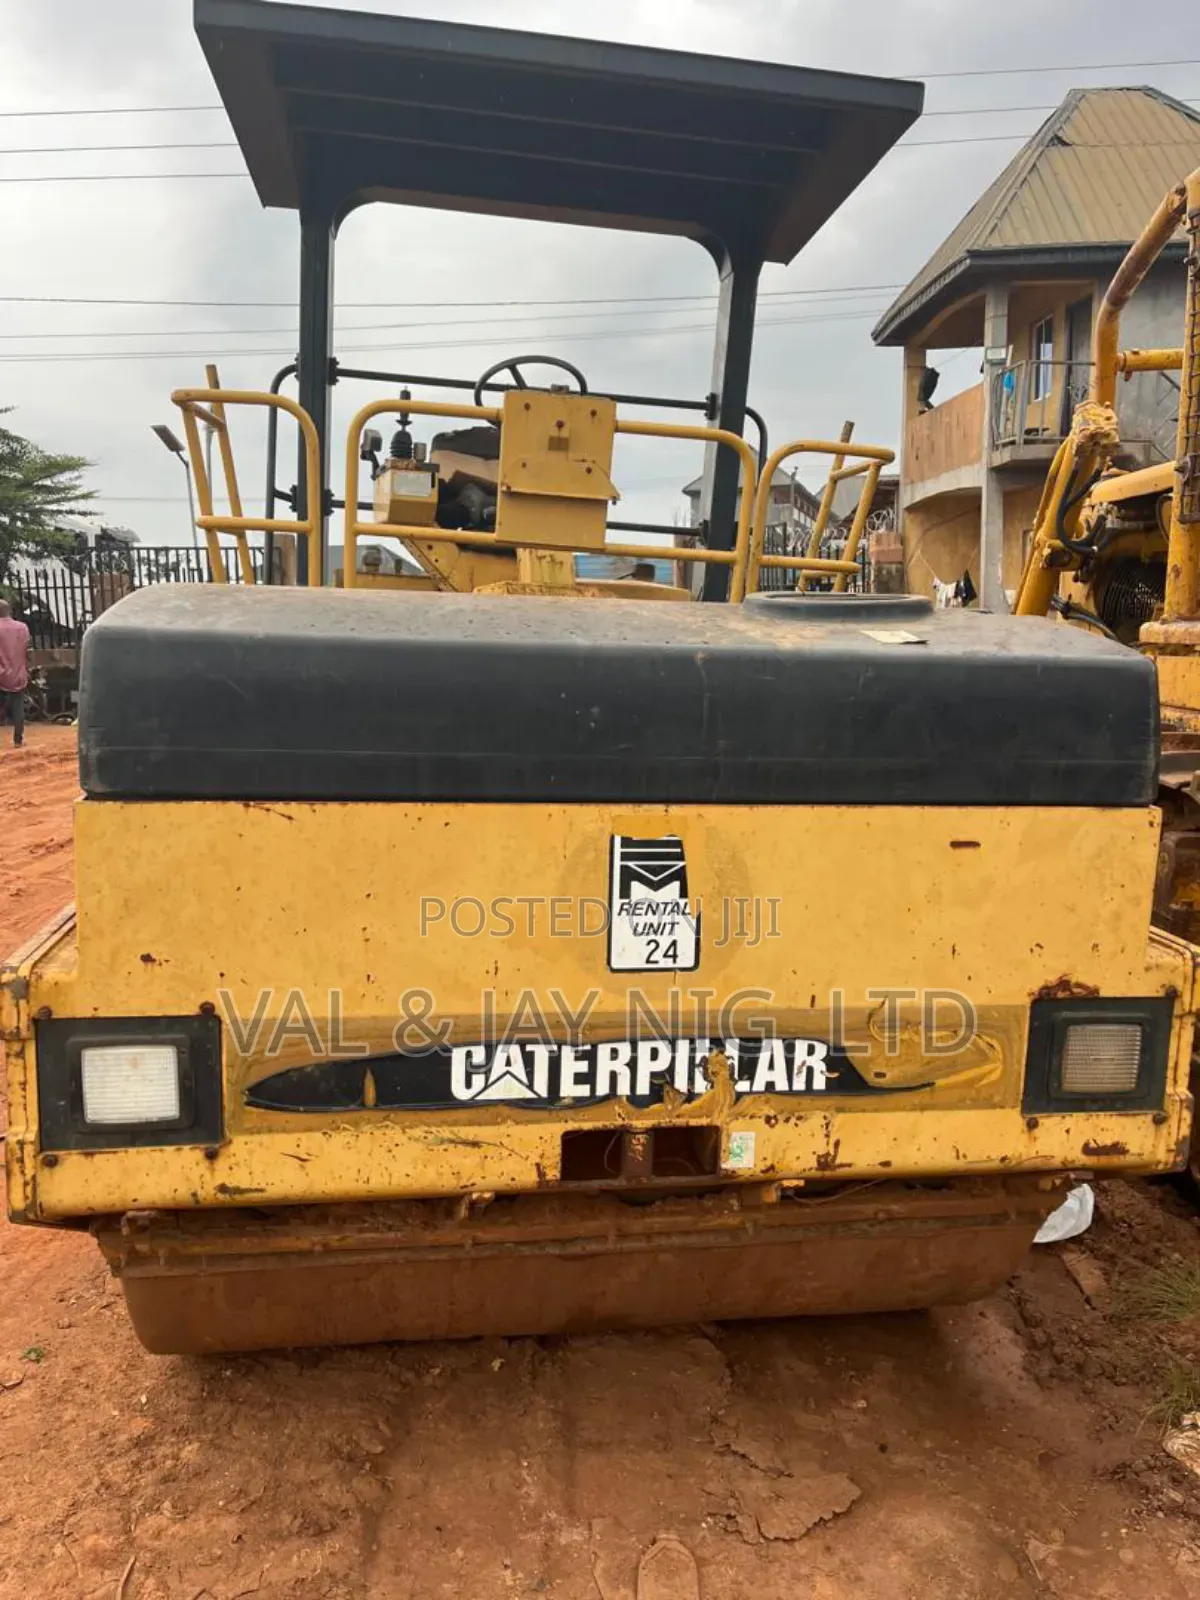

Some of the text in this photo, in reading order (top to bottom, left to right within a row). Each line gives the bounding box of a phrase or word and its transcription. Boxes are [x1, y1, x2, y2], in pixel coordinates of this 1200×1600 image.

[617, 901, 691, 917] RENTAL
[632, 922, 680, 937] UNIT
[644, 938, 679, 965] 24
